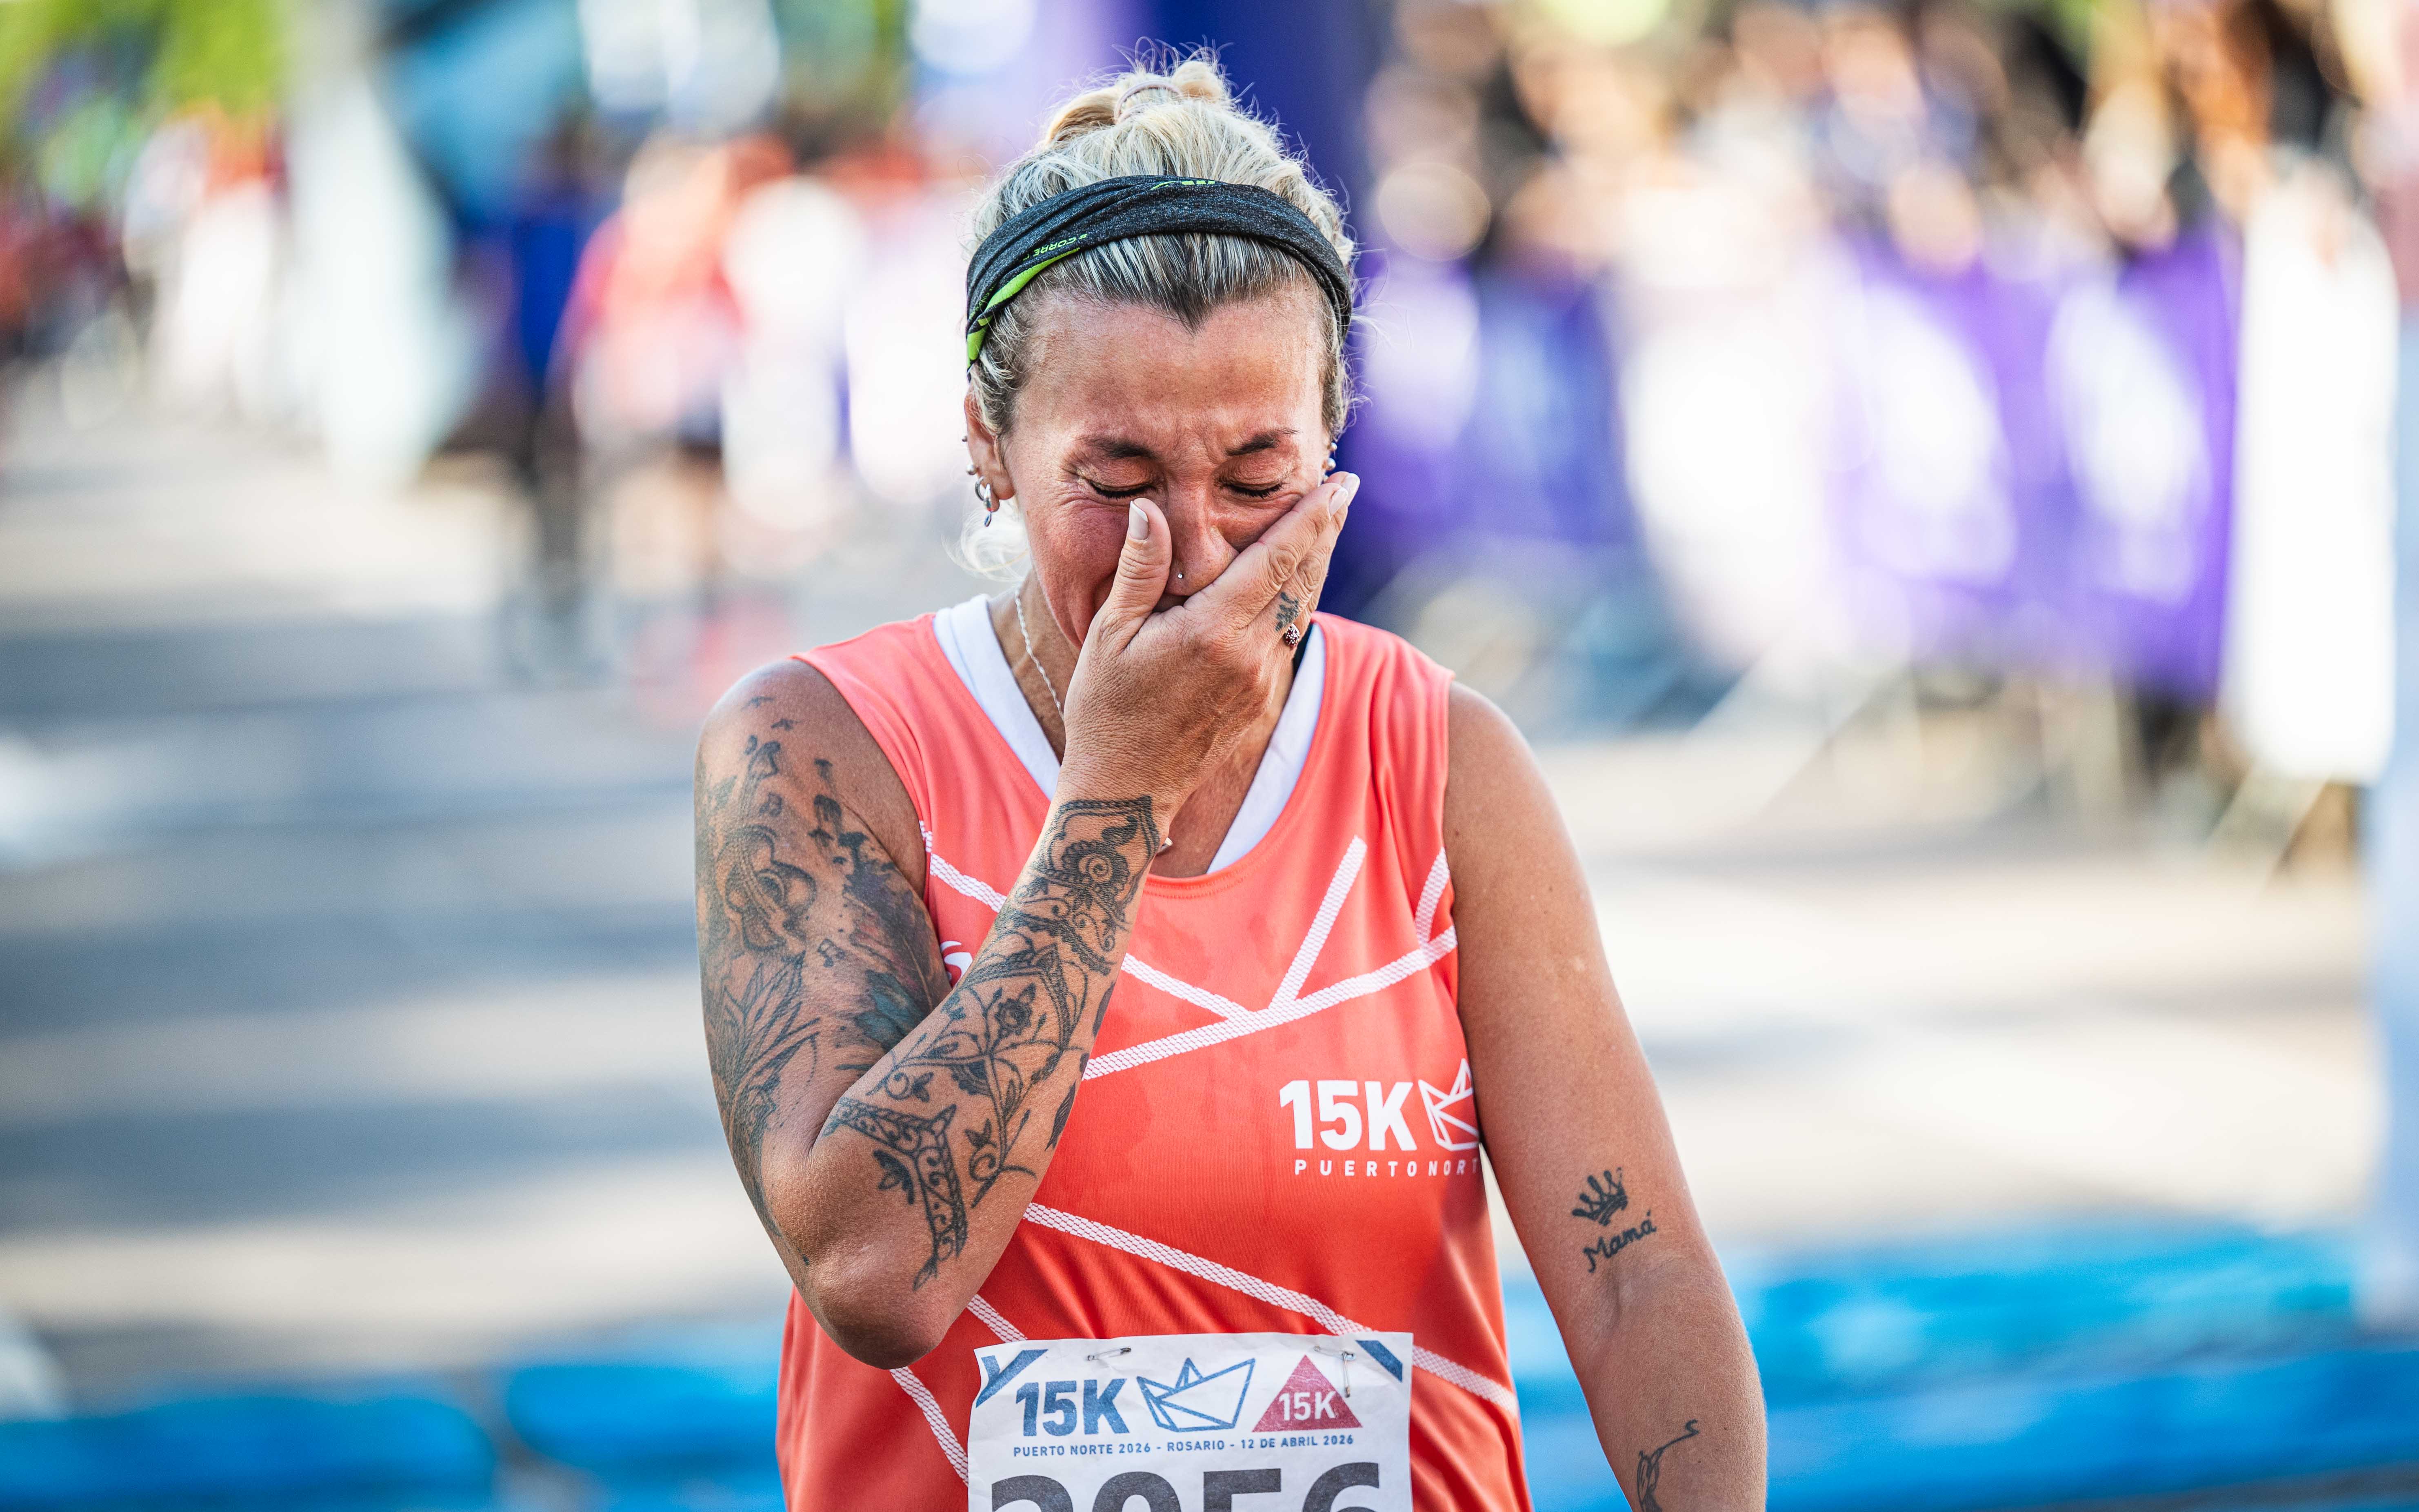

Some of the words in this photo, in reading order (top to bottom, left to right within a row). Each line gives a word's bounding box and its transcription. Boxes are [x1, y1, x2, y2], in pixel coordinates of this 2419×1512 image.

[1279, 1080, 1417, 1151] 15K
[1583, 1209, 1657, 1274] Mamá
[1016, 1379, 1130, 1437] 15K
[1278, 1392, 1337, 1421] 15K
[1013, 1445, 1065, 1457] PUERTO
[1070, 1443, 1113, 1455] NORTE
[1118, 1442, 1151, 1454] 2026
[1167, 1440, 1225, 1452] ROSARIO
[1241, 1439, 1254, 1449] 12
[1260, 1437, 1275, 1448] DE
[1281, 1436, 1318, 1447] ABRIL
[1323, 1434, 1355, 1446] 2026
